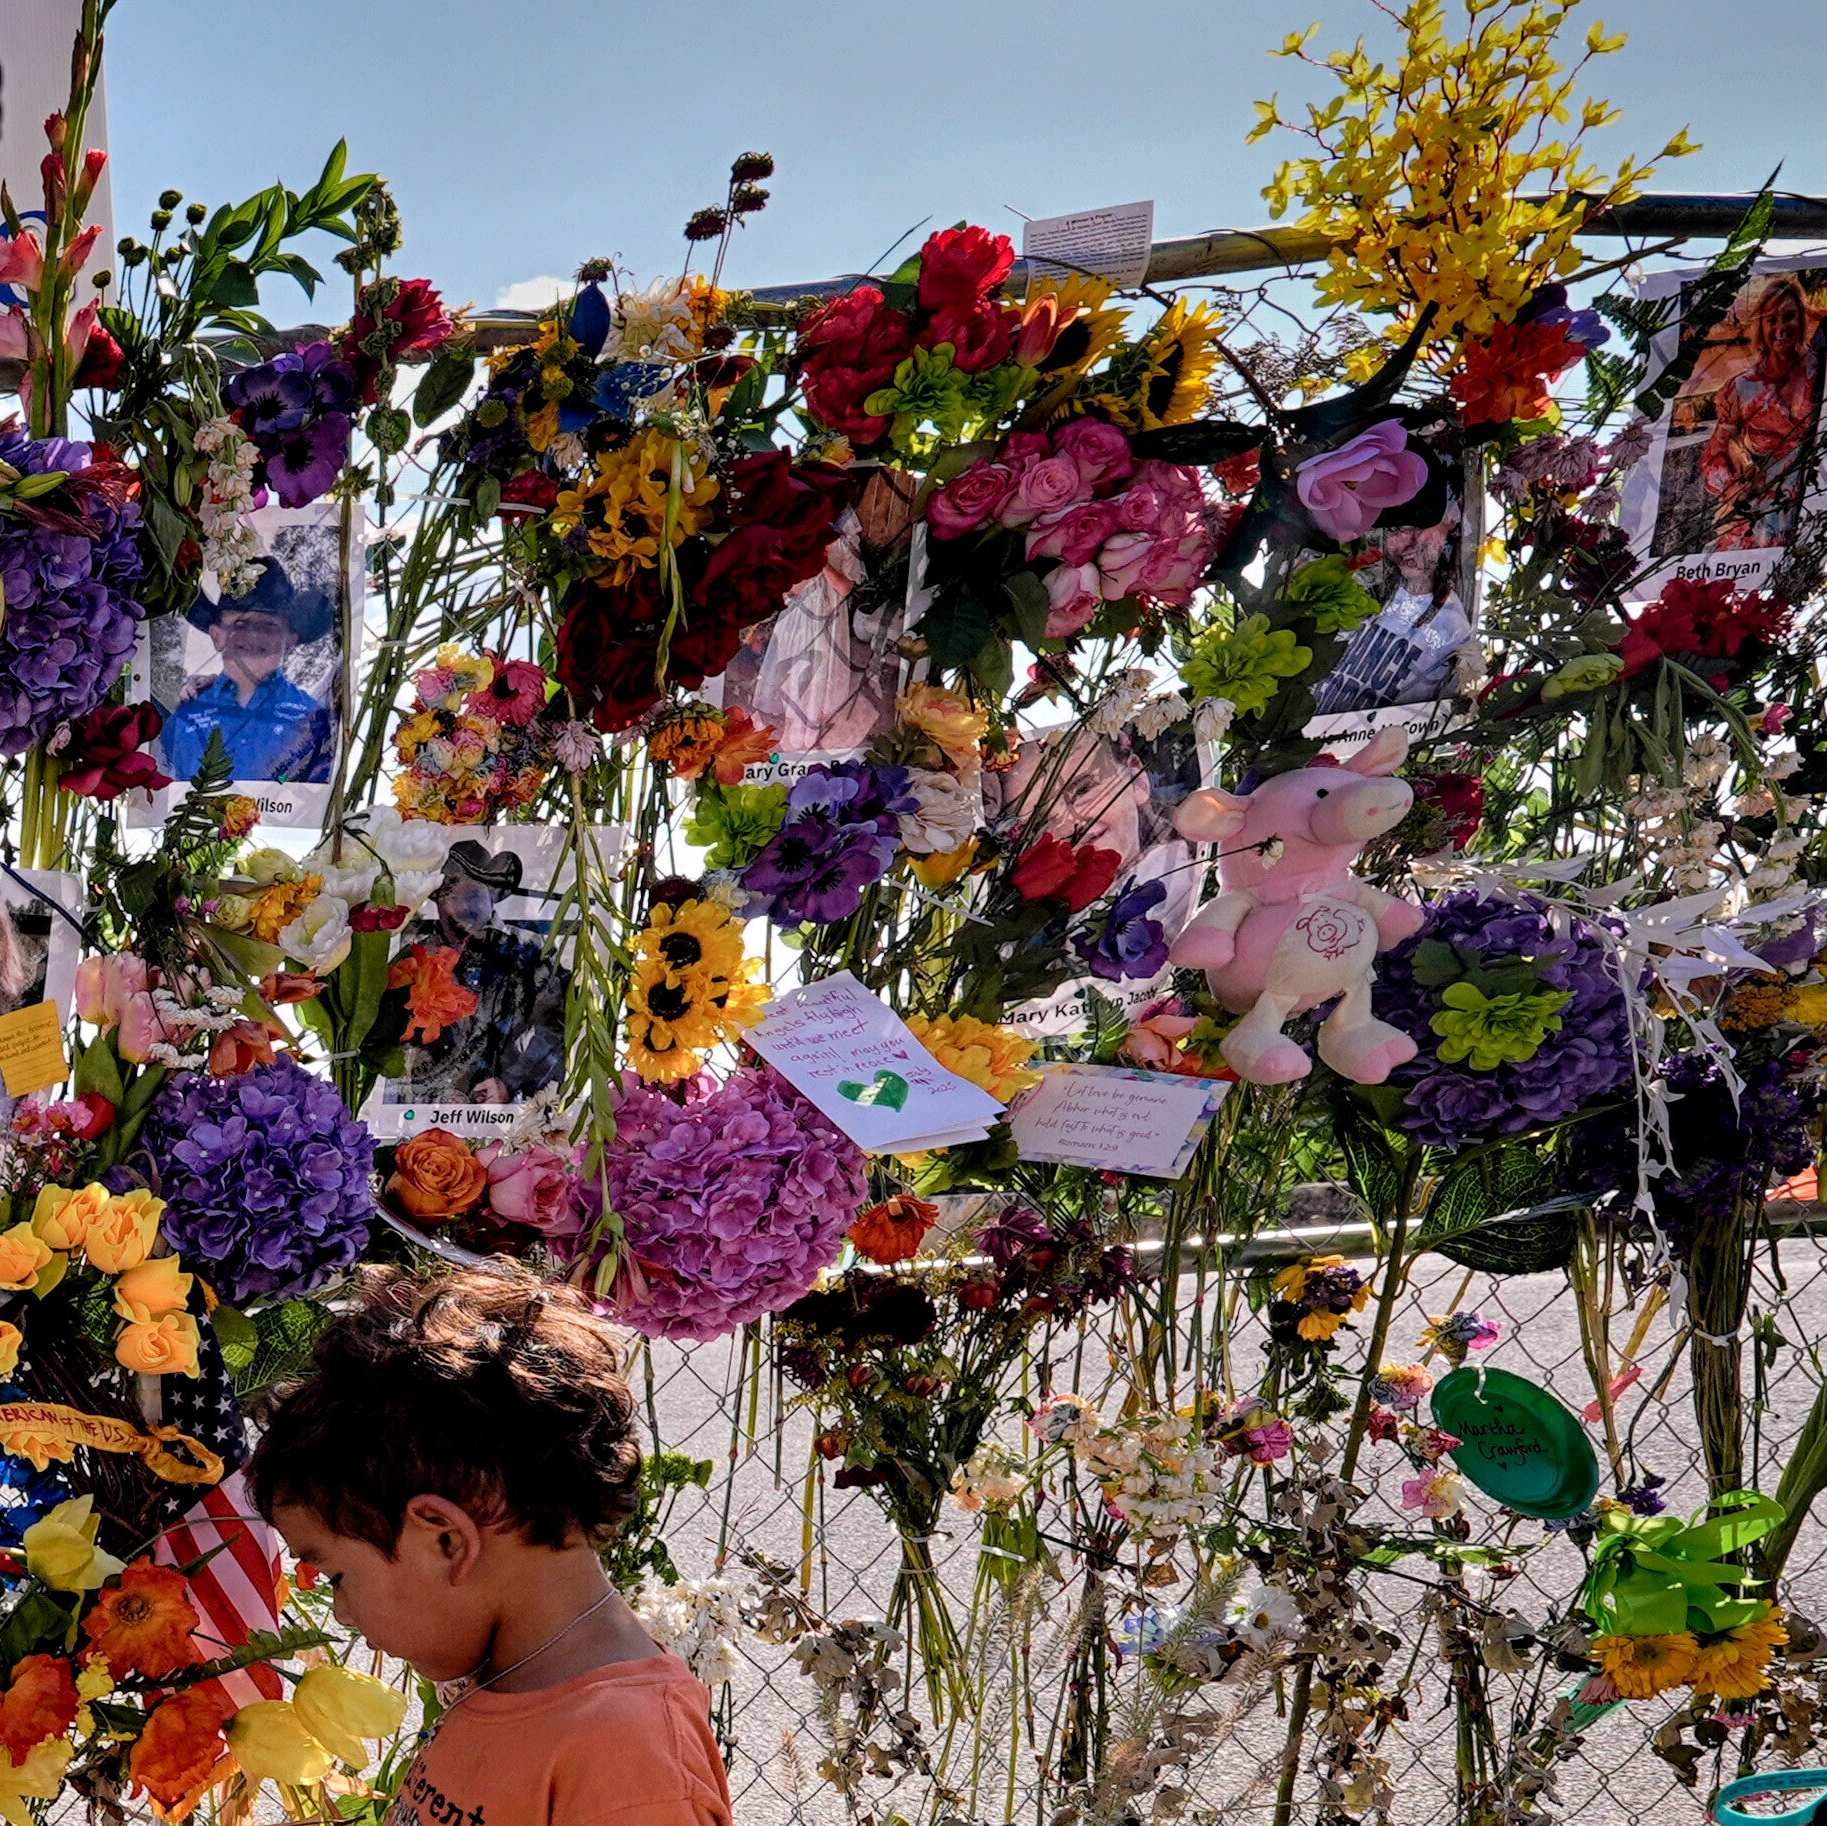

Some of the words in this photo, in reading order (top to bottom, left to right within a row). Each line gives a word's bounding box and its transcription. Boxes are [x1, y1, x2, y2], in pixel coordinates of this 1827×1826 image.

[1675, 563, 1711, 580] Beth
[1715, 562, 1761, 580] Bryan
[745, 766, 773, 781] ary
[778, 762, 811, 777] Gra
[256, 798, 293, 813] ilson
[999, 1009, 1049, 1025] Mary
[430, 1110, 463, 1124] Jeff
[466, 1110, 514, 1124] Wilson
[76, 1416, 99, 1437] THE
[1455, 1417, 1525, 1438] Martha
[1478, 1438, 1548, 1467] Crawford
